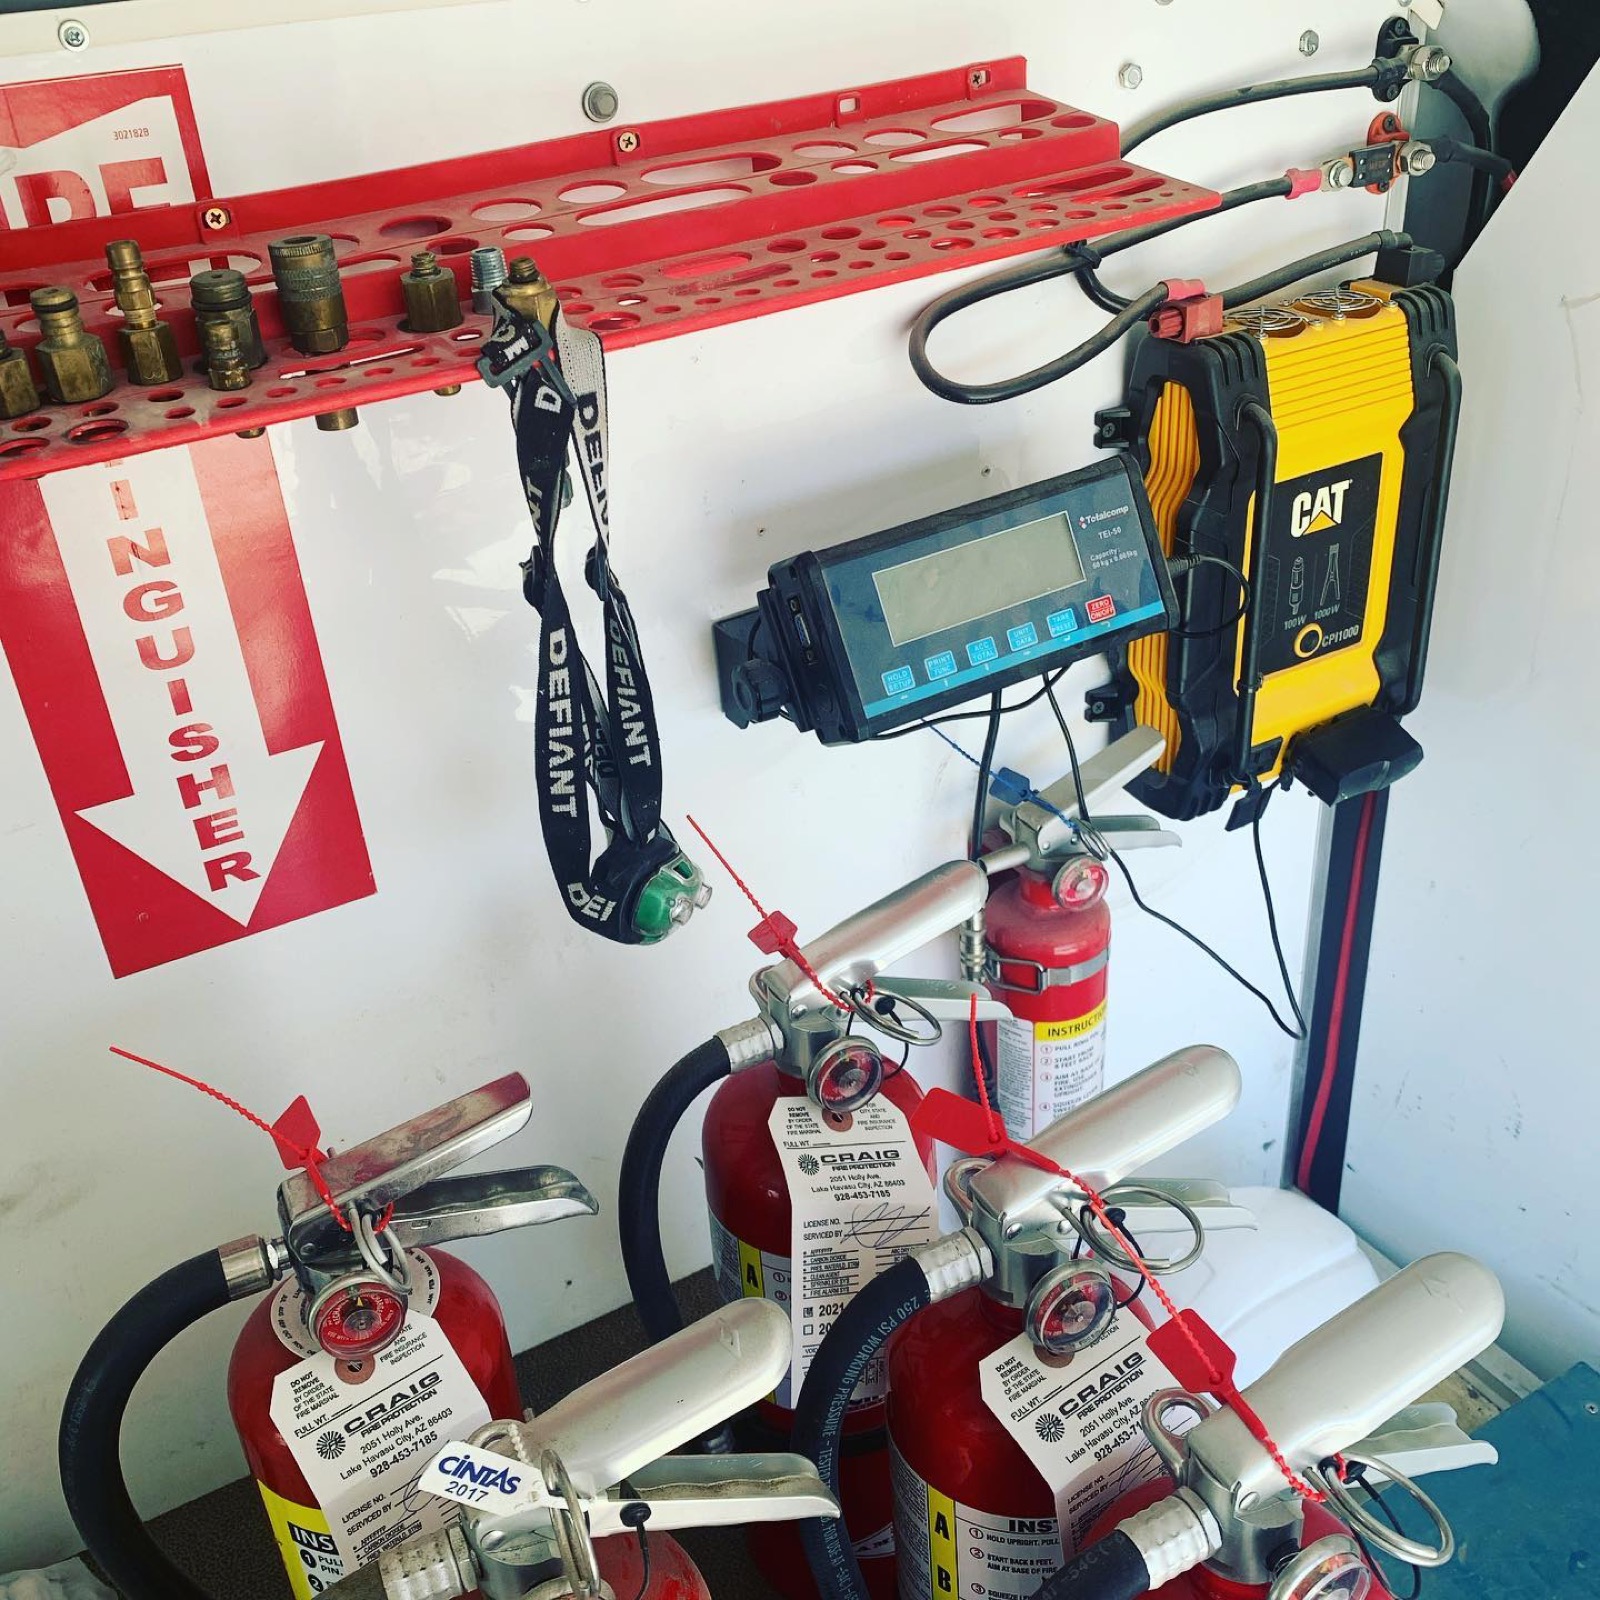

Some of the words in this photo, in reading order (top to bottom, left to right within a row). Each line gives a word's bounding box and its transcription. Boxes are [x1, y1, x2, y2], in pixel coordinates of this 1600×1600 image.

[113, 127, 150, 141] 302182B
[1085, 504, 1129, 524] Totalcomp
[1290, 479, 1350, 538] CAT
[1091, 599, 1110, 610] ZERO
[974, 641, 989, 651] ACC
[1016, 636, 1033, 646] DATA
[1321, 624, 1360, 648] CPI1000
[927, 655, 951, 667] PRINT
[972, 650, 994, 662] TOTAL
[104, 470, 262, 893] INGUISHER
[887, 670, 908, 682] HOLD
[608, 618, 652, 768] DEFIANT
[548, 627, 578, 818] DEFIANT
[820, 1150, 900, 1163] CRAIG
[849, 1161, 896, 1171] PROTECTION
[811, 1185, 829, 1193] Lake
[848, 1174, 865, 1182] Holly
[834, 1190, 891, 1202] 928-453-7185
[803, 1219, 829, 1229] LICENSE
[803, 1230, 834, 1241] SERVICED
[834, 1230, 843, 1238] BY
[746, 1262, 760, 1289] A
[896, 1295, 920, 1321] 250
[875, 1316, 899, 1339] PSI
[380, 1351, 393, 1363] FIRE
[394, 1332, 428, 1353] INSURANCE
[394, 1336, 406, 1347] AND
[389, 1343, 426, 1365] INSPECTION
[841, 1334, 885, 1386] WORKING
[995, 1363, 1005, 1373] DO
[1004, 1356, 1016, 1367] NOT
[290, 1379, 300, 1389] DO
[300, 1371, 313, 1382] NOT
[1000, 1361, 1024, 1379] REMOVE
[1002, 1379, 1011, 1387] BY
[1010, 1366, 1030, 1383] ORDER
[1003, 1387, 1012, 1395] OF
[1012, 1381, 1024, 1390] THE
[1023, 1368, 1040, 1383] STATE
[293, 1377, 320, 1395] REMOVE
[294, 1396, 302, 1404] BY
[303, 1382, 325, 1398] ORDER
[1008, 1391, 1021, 1402] FIRE
[1020, 1374, 1047, 1393] MARSHAL
[1058, 1351, 1145, 1417] CRAIG
[1077, 1404, 1096, 1420] FIRE
[1095, 1368, 1144, 1407] PROTECTION
[293, 1404, 302, 1412] OF
[304, 1397, 315, 1407] THE
[315, 1385, 336, 1400] STATE
[296, 1408, 310, 1420] FIRE
[310, 1392, 340, 1411] MARSHAL
[344, 1371, 440, 1434] CRAIG
[360, 1422, 382, 1438] FIRE
[381, 1388, 438, 1426] PROTECTION
[821, 1385, 851, 1439] PRESSURE
[1010, 1405, 1030, 1421] FULL
[1079, 1420, 1100, 1438] 2051
[1099, 1406, 1119, 1423] Holly
[1118, 1396, 1136, 1411] Ave.
[294, 1422, 315, 1437] FULL
[360, 1437, 382, 1455] 2051
[382, 1424, 404, 1441] Holly
[404, 1414, 423, 1429] Ave.
[1065, 1446, 1086, 1464] Lake
[1084, 1426, 1114, 1450] Havasu
[1112, 1415, 1131, 1429] City,
[1128, 1404, 1142, 1418] AZ
[340, 1464, 362, 1480] Lake
[362, 1444, 395, 1467] Havasu
[395, 1433, 415, 1447] City,
[414, 1423, 428, 1436] AZ
[428, 1407, 453, 1427] 86403
[370, 1430, 438, 1478] 928-453-7185
[438, 1454, 521, 1495] CINTAS
[445, 1480, 489, 1502] 2017
[1067, 1480, 1095, 1504] LICENSE
[1068, 1489, 1100, 1514] SERVICED
[1098, 1482, 1109, 1494] BY
[341, 1500, 373, 1524] LICENSE
[346, 1509, 382, 1536] SERVICED
[382, 1501, 393, 1513] BY
[934, 1511, 950, 1541] A
[986, 1534, 1005, 1544] HOLD
[321, 1565, 344, 1577] PIN.
[987, 1553, 1009, 1564] START
[1009, 1558, 1029, 1566] BACK
[987, 1563, 1001, 1571] AIM
[1011, 1566, 1030, 1574] BASE
[937, 1564, 951, 1593] B
